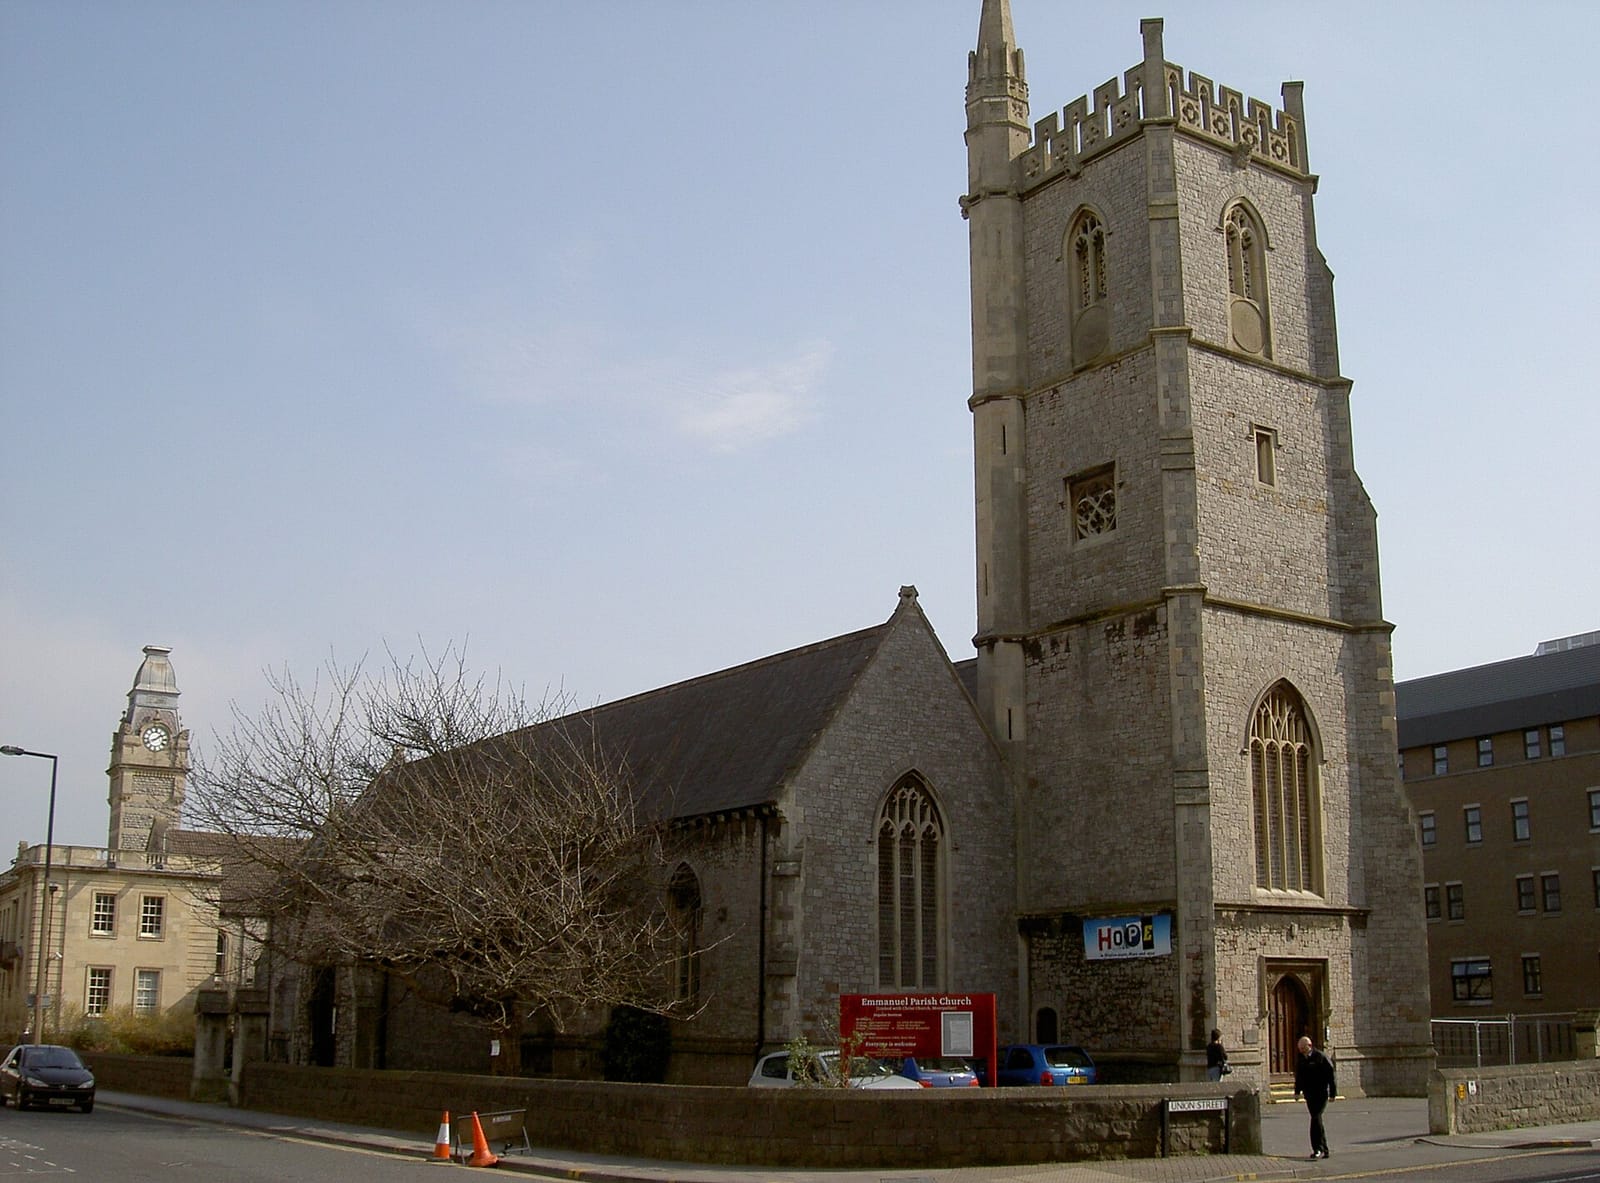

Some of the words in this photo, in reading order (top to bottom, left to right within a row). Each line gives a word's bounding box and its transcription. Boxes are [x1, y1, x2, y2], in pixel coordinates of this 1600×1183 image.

[1098, 924, 1153, 951] HOPE
[861, 997, 908, 1006] Emmanuel
[910, 997, 937, 1006] Parish
[940, 996, 972, 1006] Church
[1171, 1101, 1195, 1110] UNION
[1197, 1100, 1224, 1109] STREET
